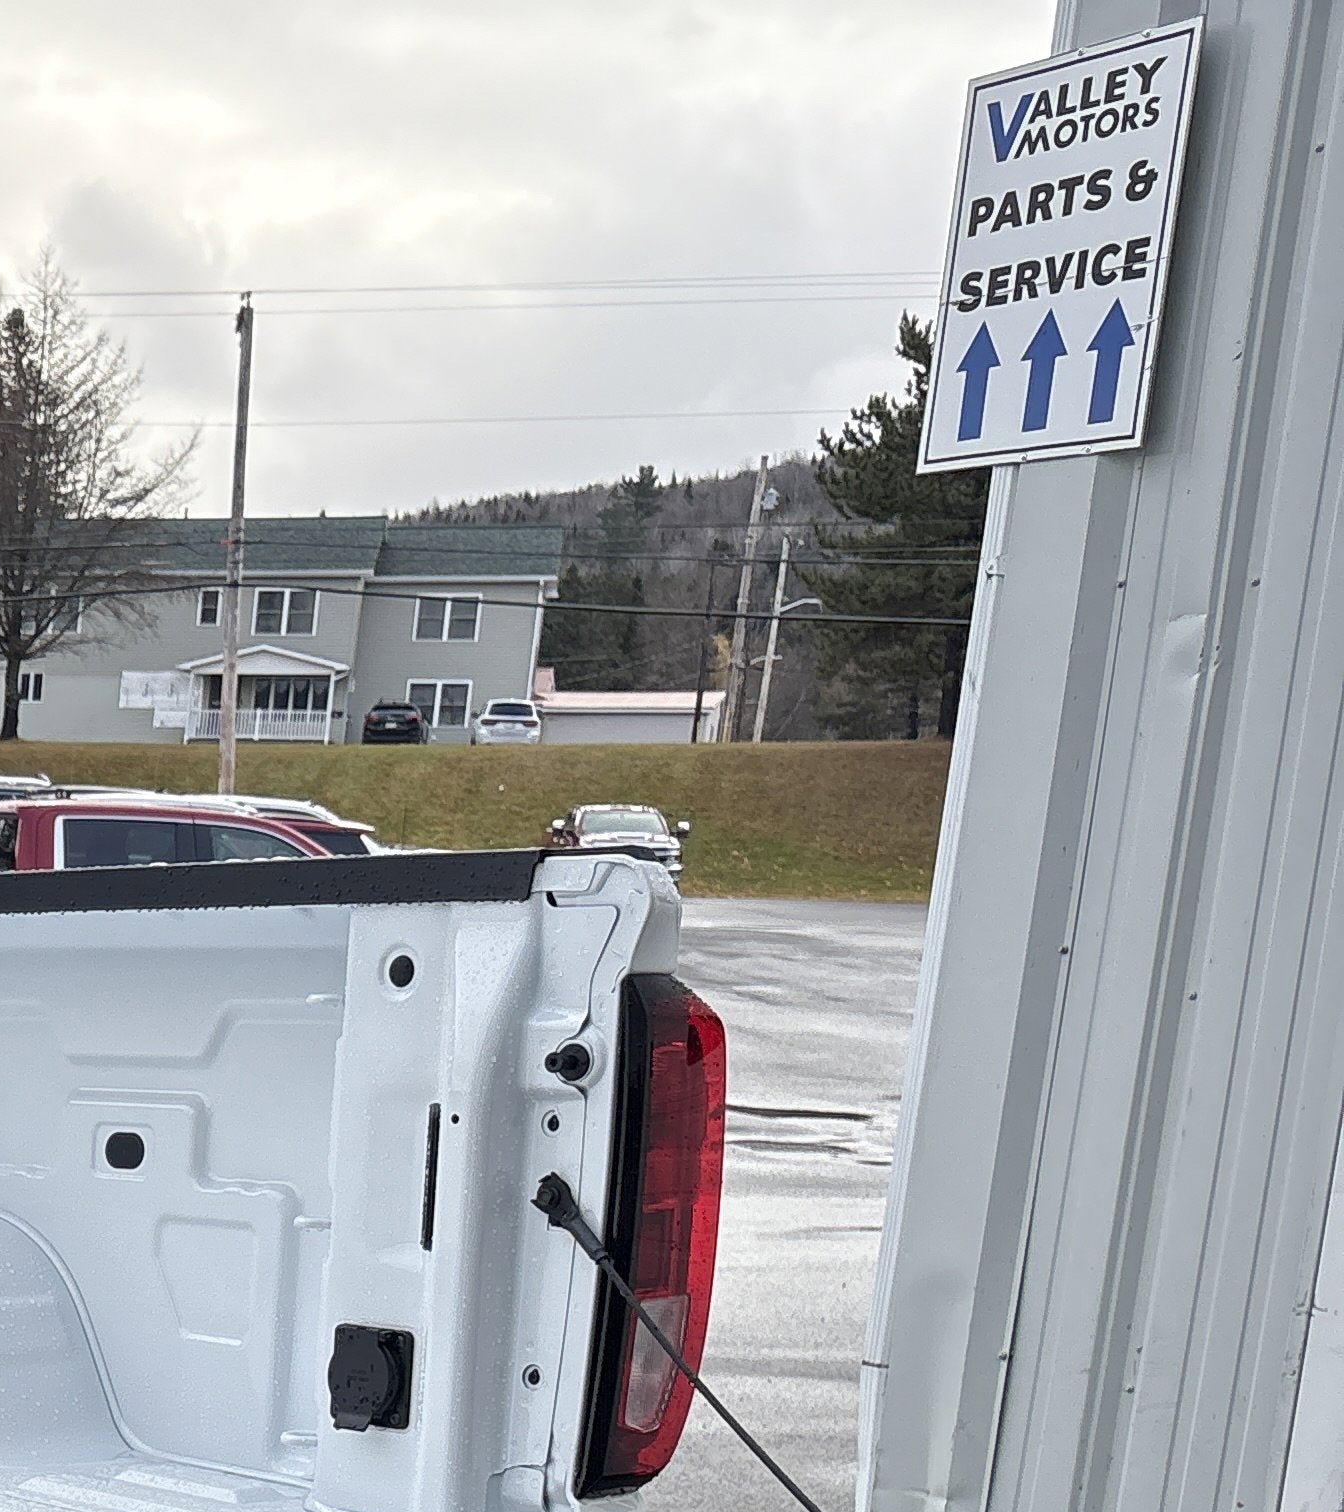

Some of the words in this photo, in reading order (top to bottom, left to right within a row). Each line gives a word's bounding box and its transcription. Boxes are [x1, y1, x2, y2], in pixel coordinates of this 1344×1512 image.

[987, 56, 1168, 163] VALLEY
[1013, 96, 1161, 159] MOTORS
[967, 168, 1113, 237] PARTS
[1125, 159, 1159, 202] &
[957, 236, 1152, 313] SERVICE
